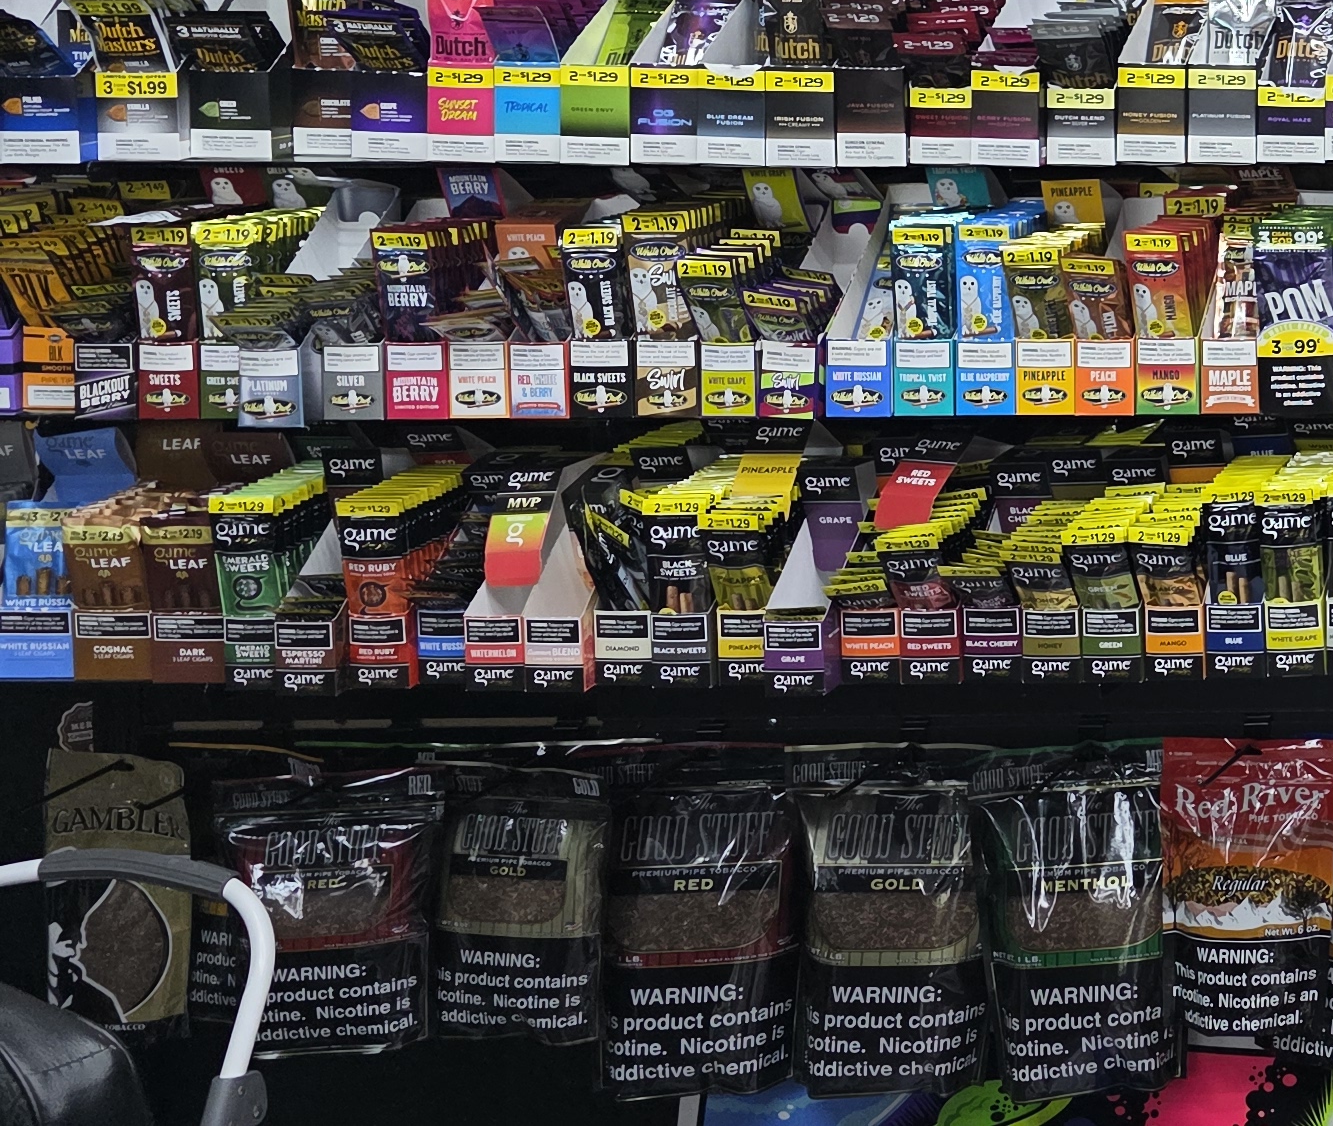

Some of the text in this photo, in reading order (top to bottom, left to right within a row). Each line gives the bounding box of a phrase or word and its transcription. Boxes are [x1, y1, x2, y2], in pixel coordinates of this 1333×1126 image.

[435, 35, 488, 58] Dutch
[103, 80, 167, 95] 3 $1.99
[438, 97, 479, 110] SUNSET
[441, 107, 478, 122] DREAM
[336, 375, 364, 387] SILVER
[1023, 370, 1065, 382] PINEAPPLE
[1152, 369, 1180, 381] MANGO
[392, 378, 438, 388] MOUNTAIN
[392, 387, 439, 402] BERRY
[507, 496, 542, 510] MVP
[344, 526, 397, 552] game
[781, 655, 805, 663] GRAPE
[52, 805, 185, 841] GAMBLER
[673, 878, 713, 891] RED
[1212, 874, 1268, 895] Regular
[631, 985, 744, 1006] WARNING:
[702, 1047, 788, 1075] chemical.
